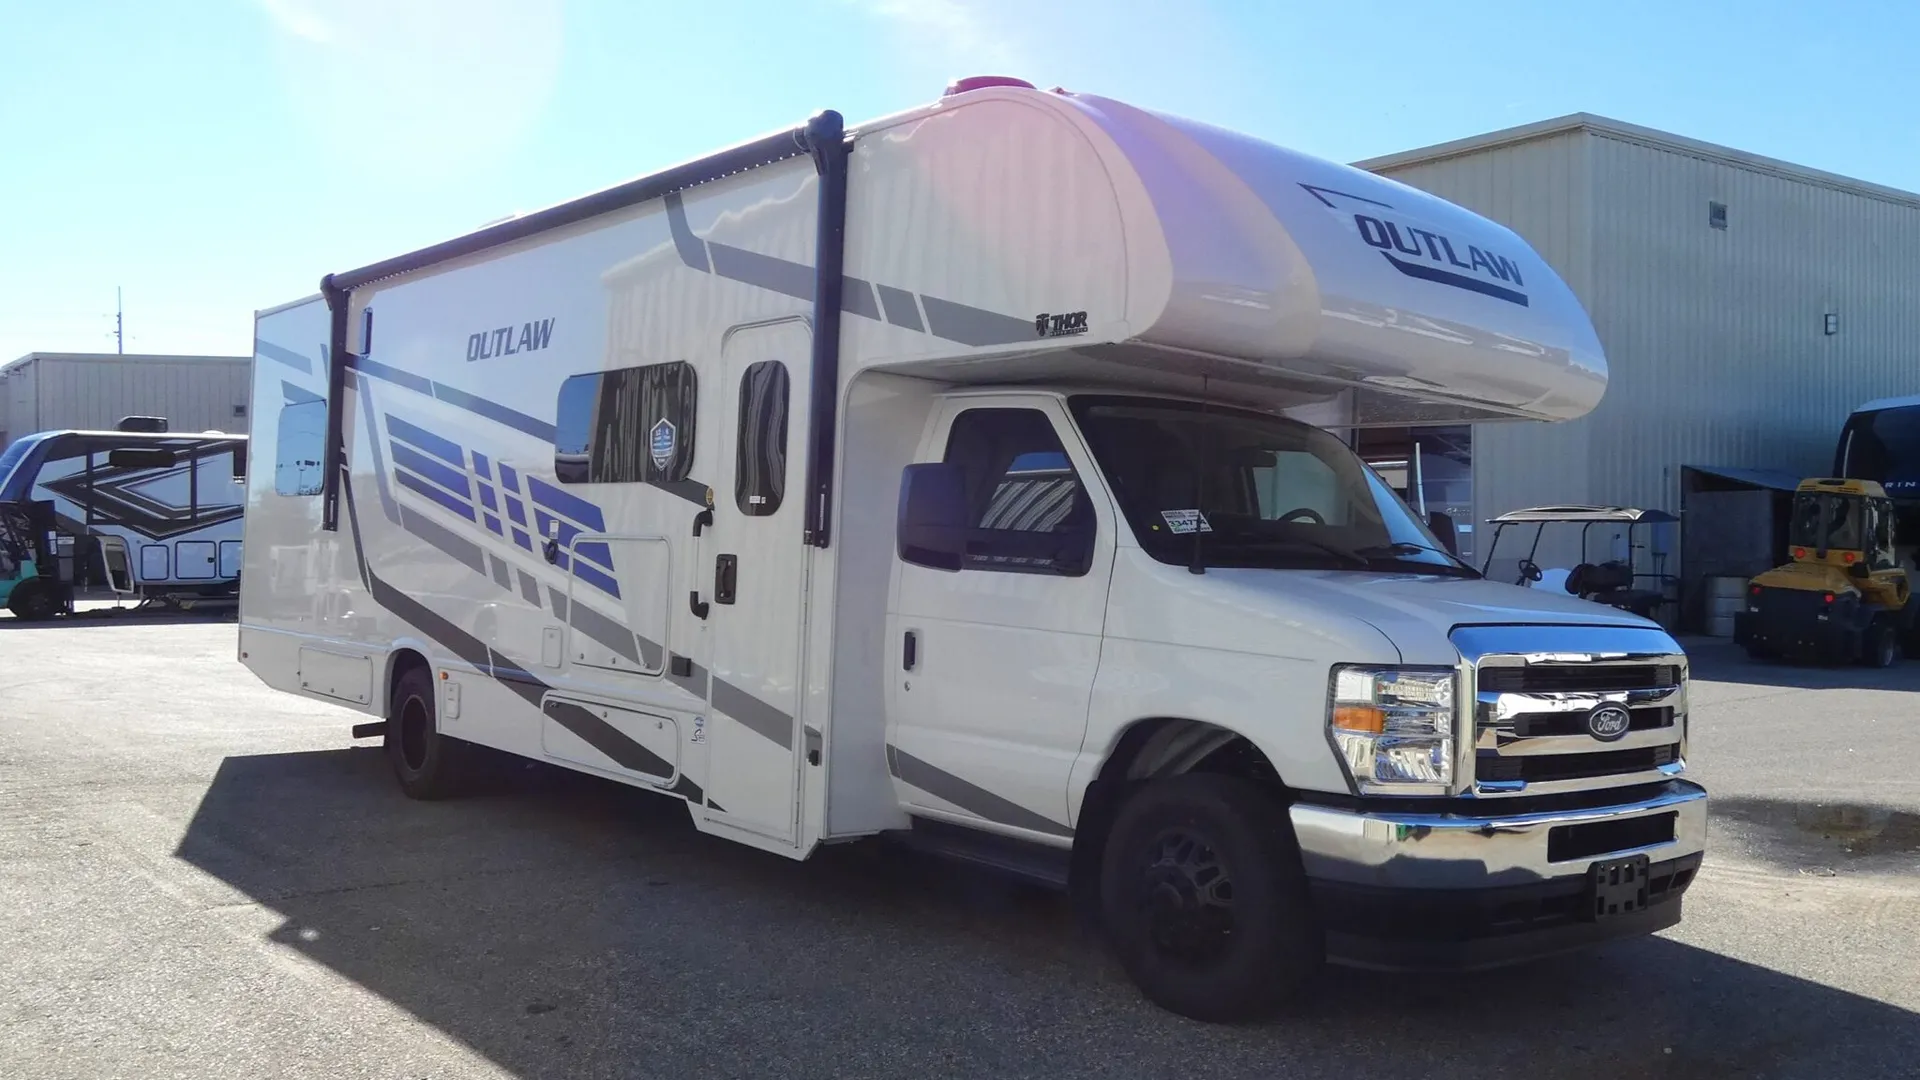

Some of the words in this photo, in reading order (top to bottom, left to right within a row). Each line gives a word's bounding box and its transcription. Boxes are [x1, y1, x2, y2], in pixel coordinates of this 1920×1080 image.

[1354, 214, 1524, 287] OUTLAW
[1050, 311, 1088, 331] THOR
[466, 317, 556, 362] OUTLAW
[1597, 711, 1623, 732] Ford
